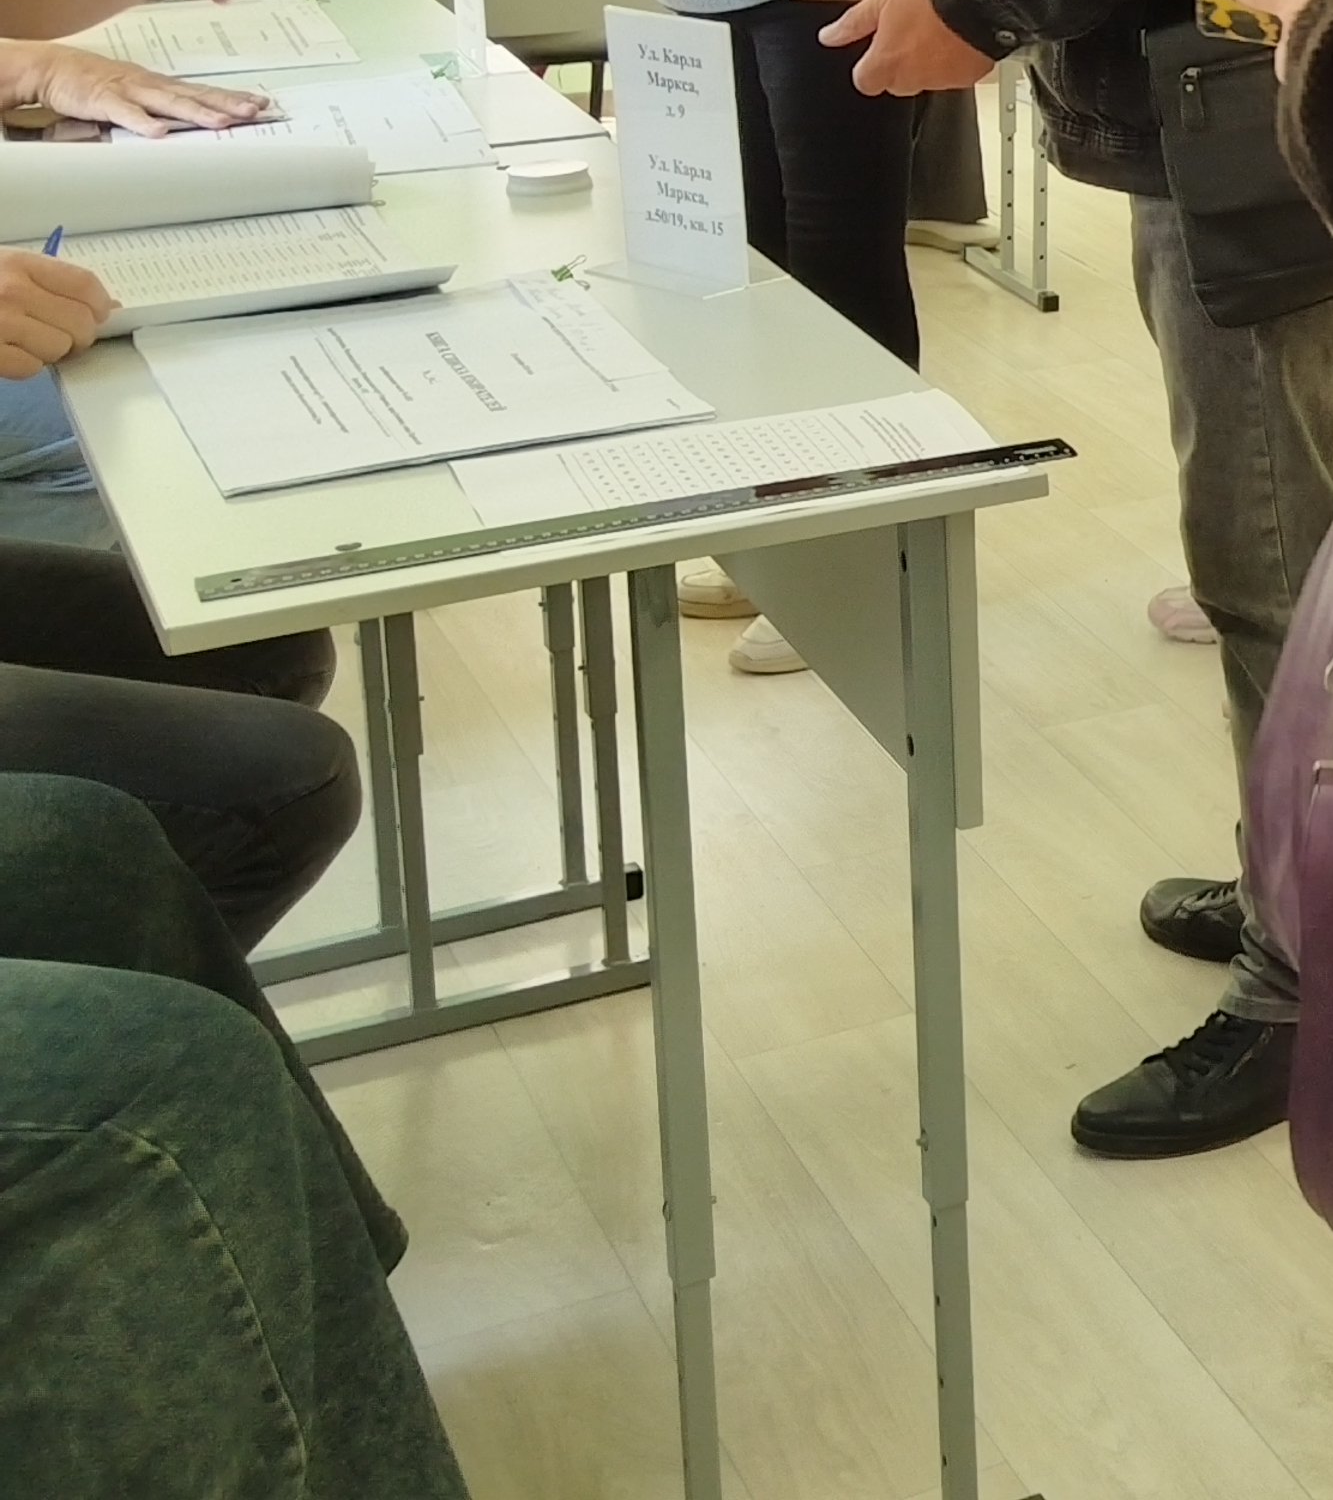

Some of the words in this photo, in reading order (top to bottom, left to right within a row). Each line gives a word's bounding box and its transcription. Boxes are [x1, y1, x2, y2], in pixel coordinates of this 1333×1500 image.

[638, 43, 660, 61] Ул.
[663, 47, 702, 71] Карла
[647, 70, 700, 96] Маркса,
[677, 103, 686, 119] 9
[648, 153, 671, 173] Ул.
[673, 158, 712, 182] Карла
[657, 180, 709, 207] Маркса,
[711, 221, 724, 237] 15
